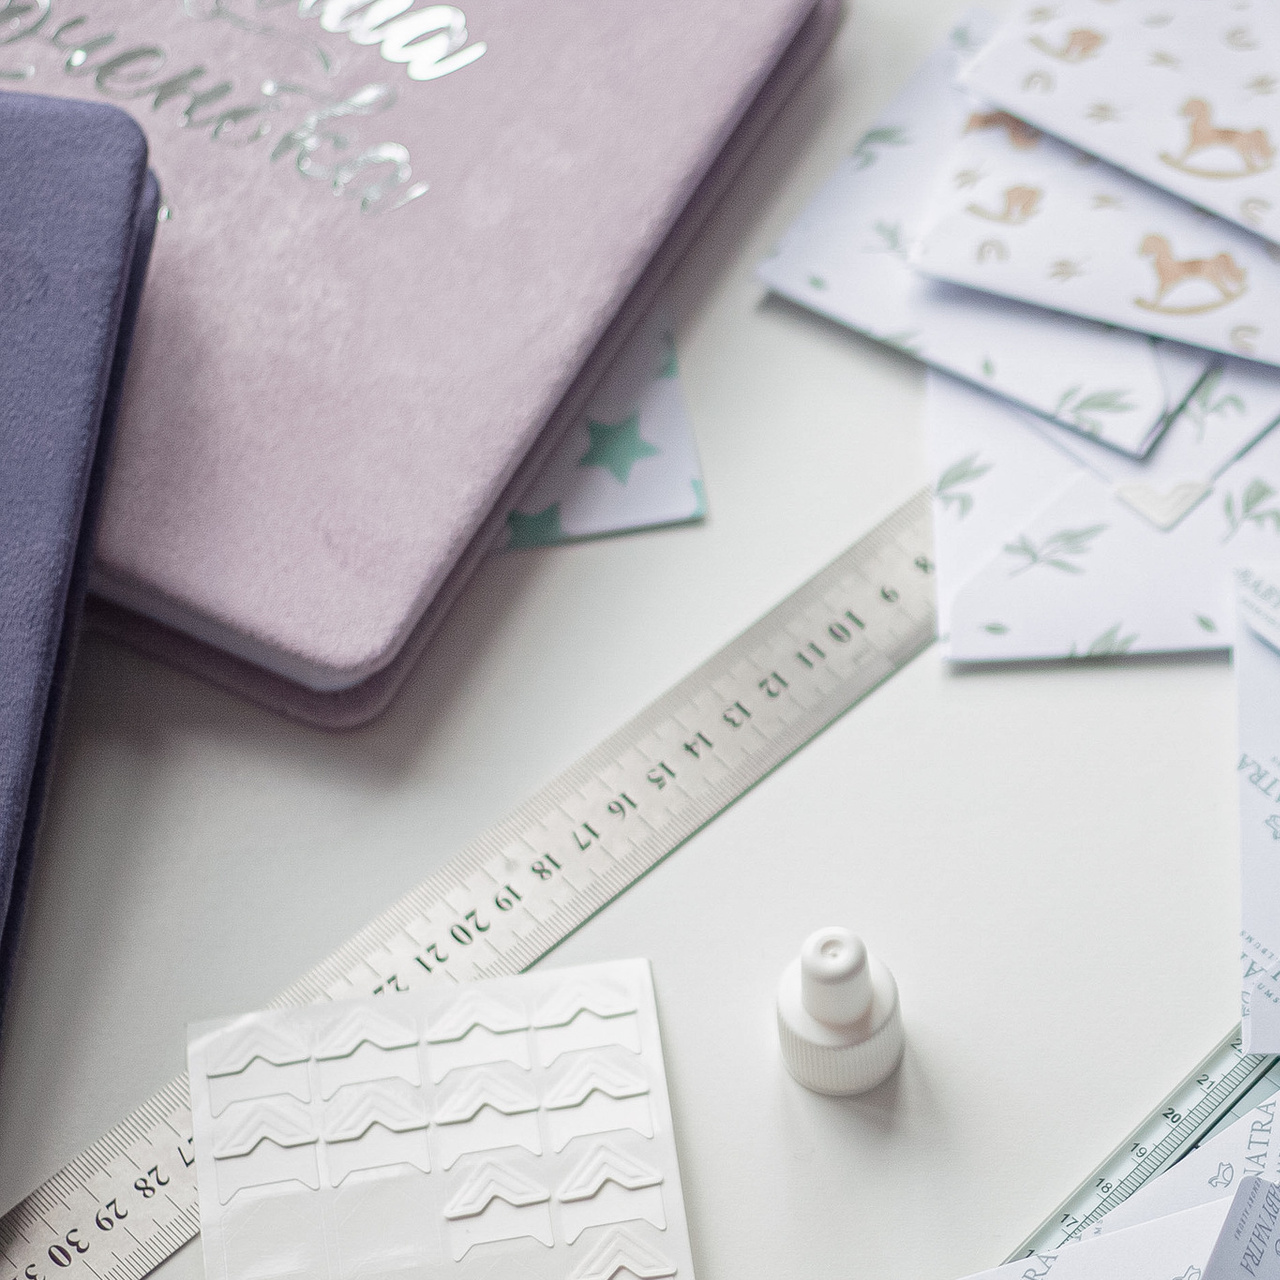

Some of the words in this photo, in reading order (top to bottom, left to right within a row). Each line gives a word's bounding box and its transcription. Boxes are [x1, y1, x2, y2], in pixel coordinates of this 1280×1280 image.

[827, 609, 866, 644] 10
[795, 641, 827, 670] 11
[758, 671, 789, 698] 12
[722, 700, 752, 729] 13
[682, 731, 714, 759] 14
[646, 760, 677, 791] 15
[607, 792, 638, 819] 16
[572, 821, 601, 852] 17
[530, 853, 562, 881] 18
[494, 884, 523, 912] 19
[449, 908, 491, 946] 20
[414, 942, 450, 974] 21
[1195, 1073, 1216, 1091] 21
[1161, 1107, 1183, 1125] 20
[1130, 1141, 1149, 1159] 19
[133, 1165, 171, 1199] 28
[1095, 1176, 1114, 1195] 18
[94, 1197, 129, 1232] 29
[1059, 1212, 1080, 1228] 17
[46, 1227, 91, 1268] 30
[1239, 1214, 1273, 1278] NATRA
